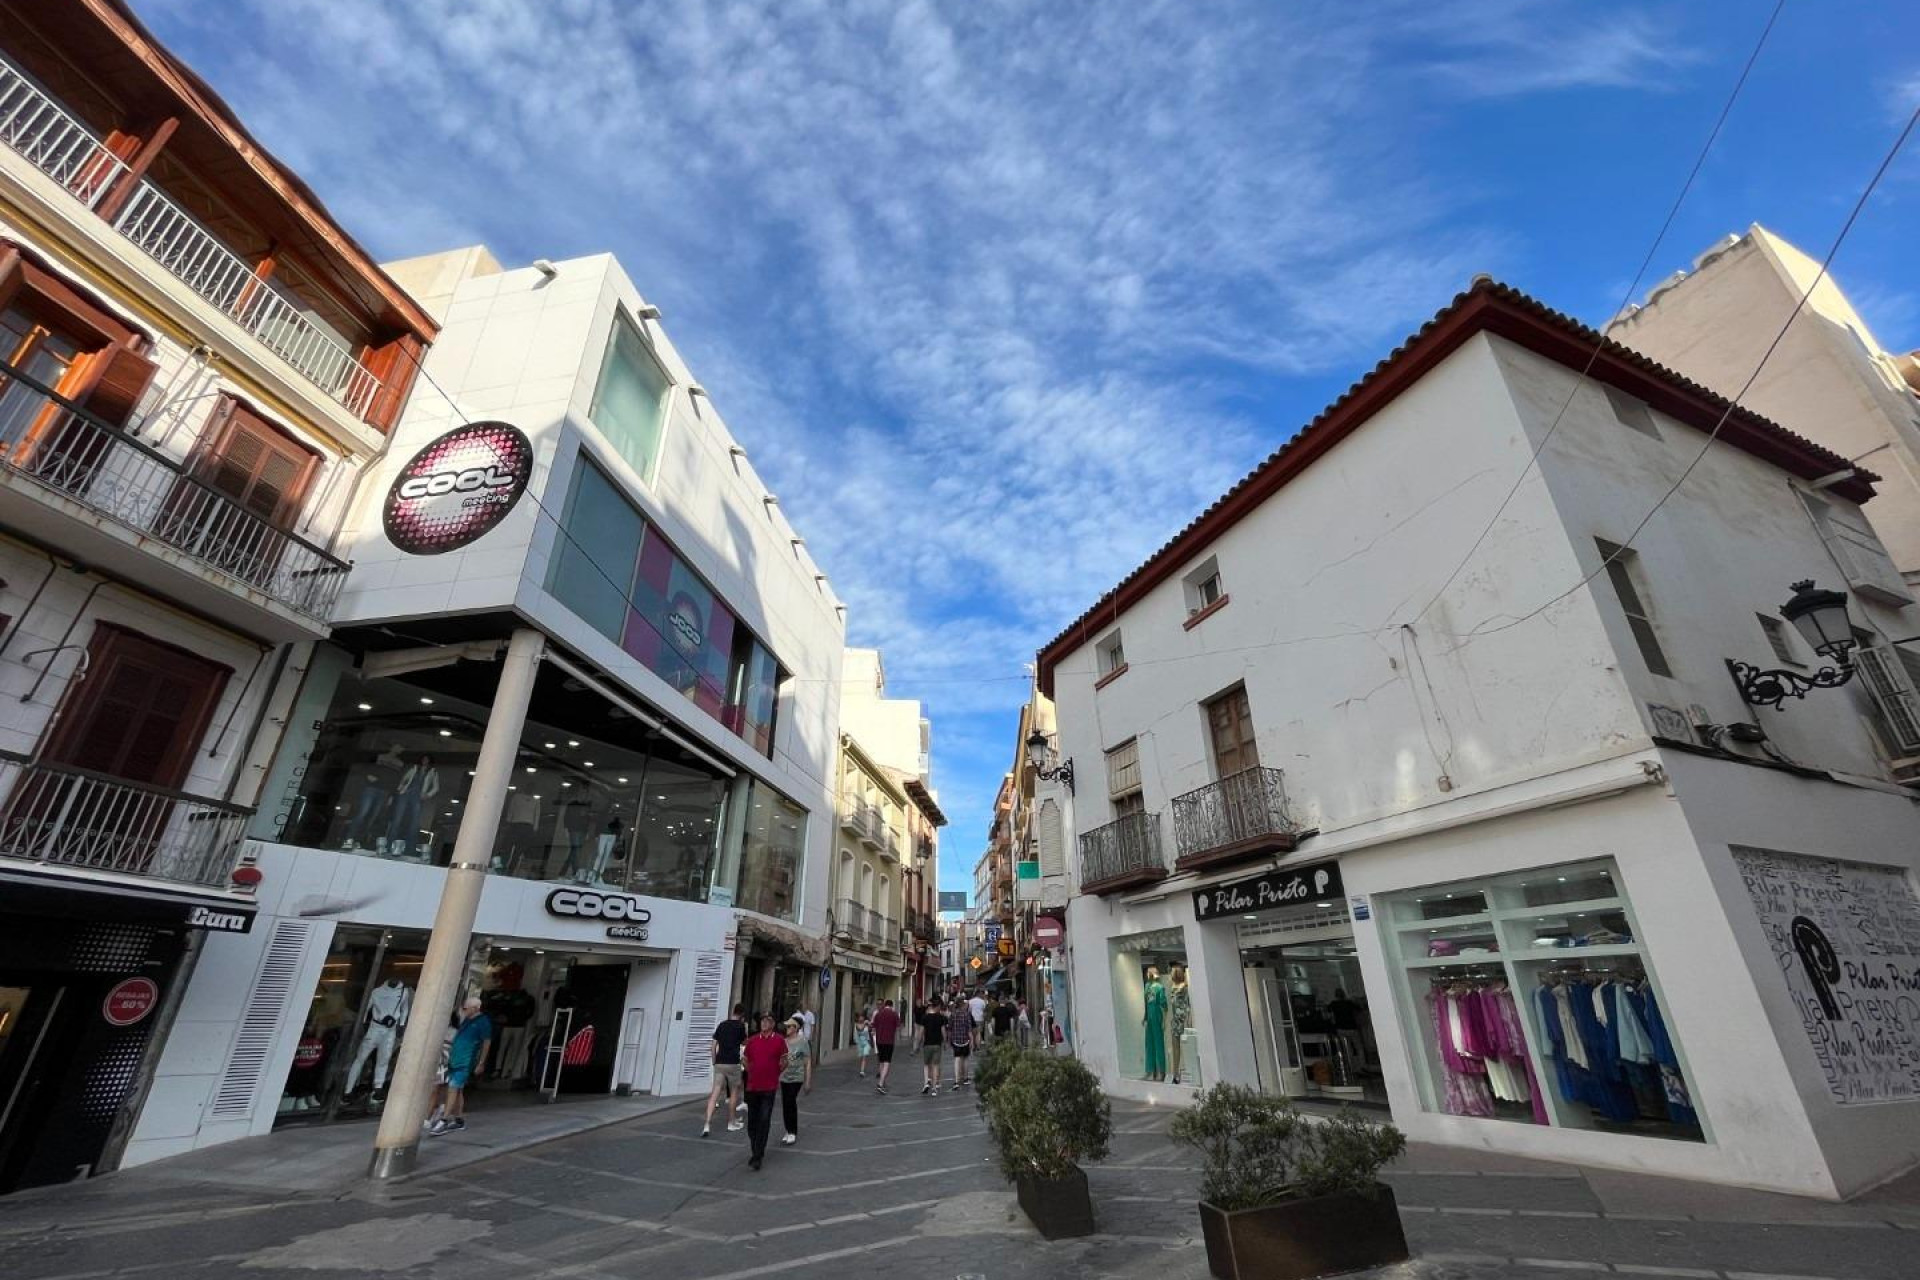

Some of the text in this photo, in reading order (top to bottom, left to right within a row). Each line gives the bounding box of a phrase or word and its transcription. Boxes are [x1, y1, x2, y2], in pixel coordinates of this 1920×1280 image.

[400, 466, 513, 499] COOL
[462, 494, 510, 508] meeting
[1216, 887, 1254, 912] Pilar
[1258, 877, 1308, 904] Prieto
[1743, 876, 1786, 896] Pilar
[1790, 881, 1844, 902] Prieto
[546, 889, 651, 923] COOL
[606, 926, 648, 940] meeting
[1844, 961, 1888, 990] Pilar
